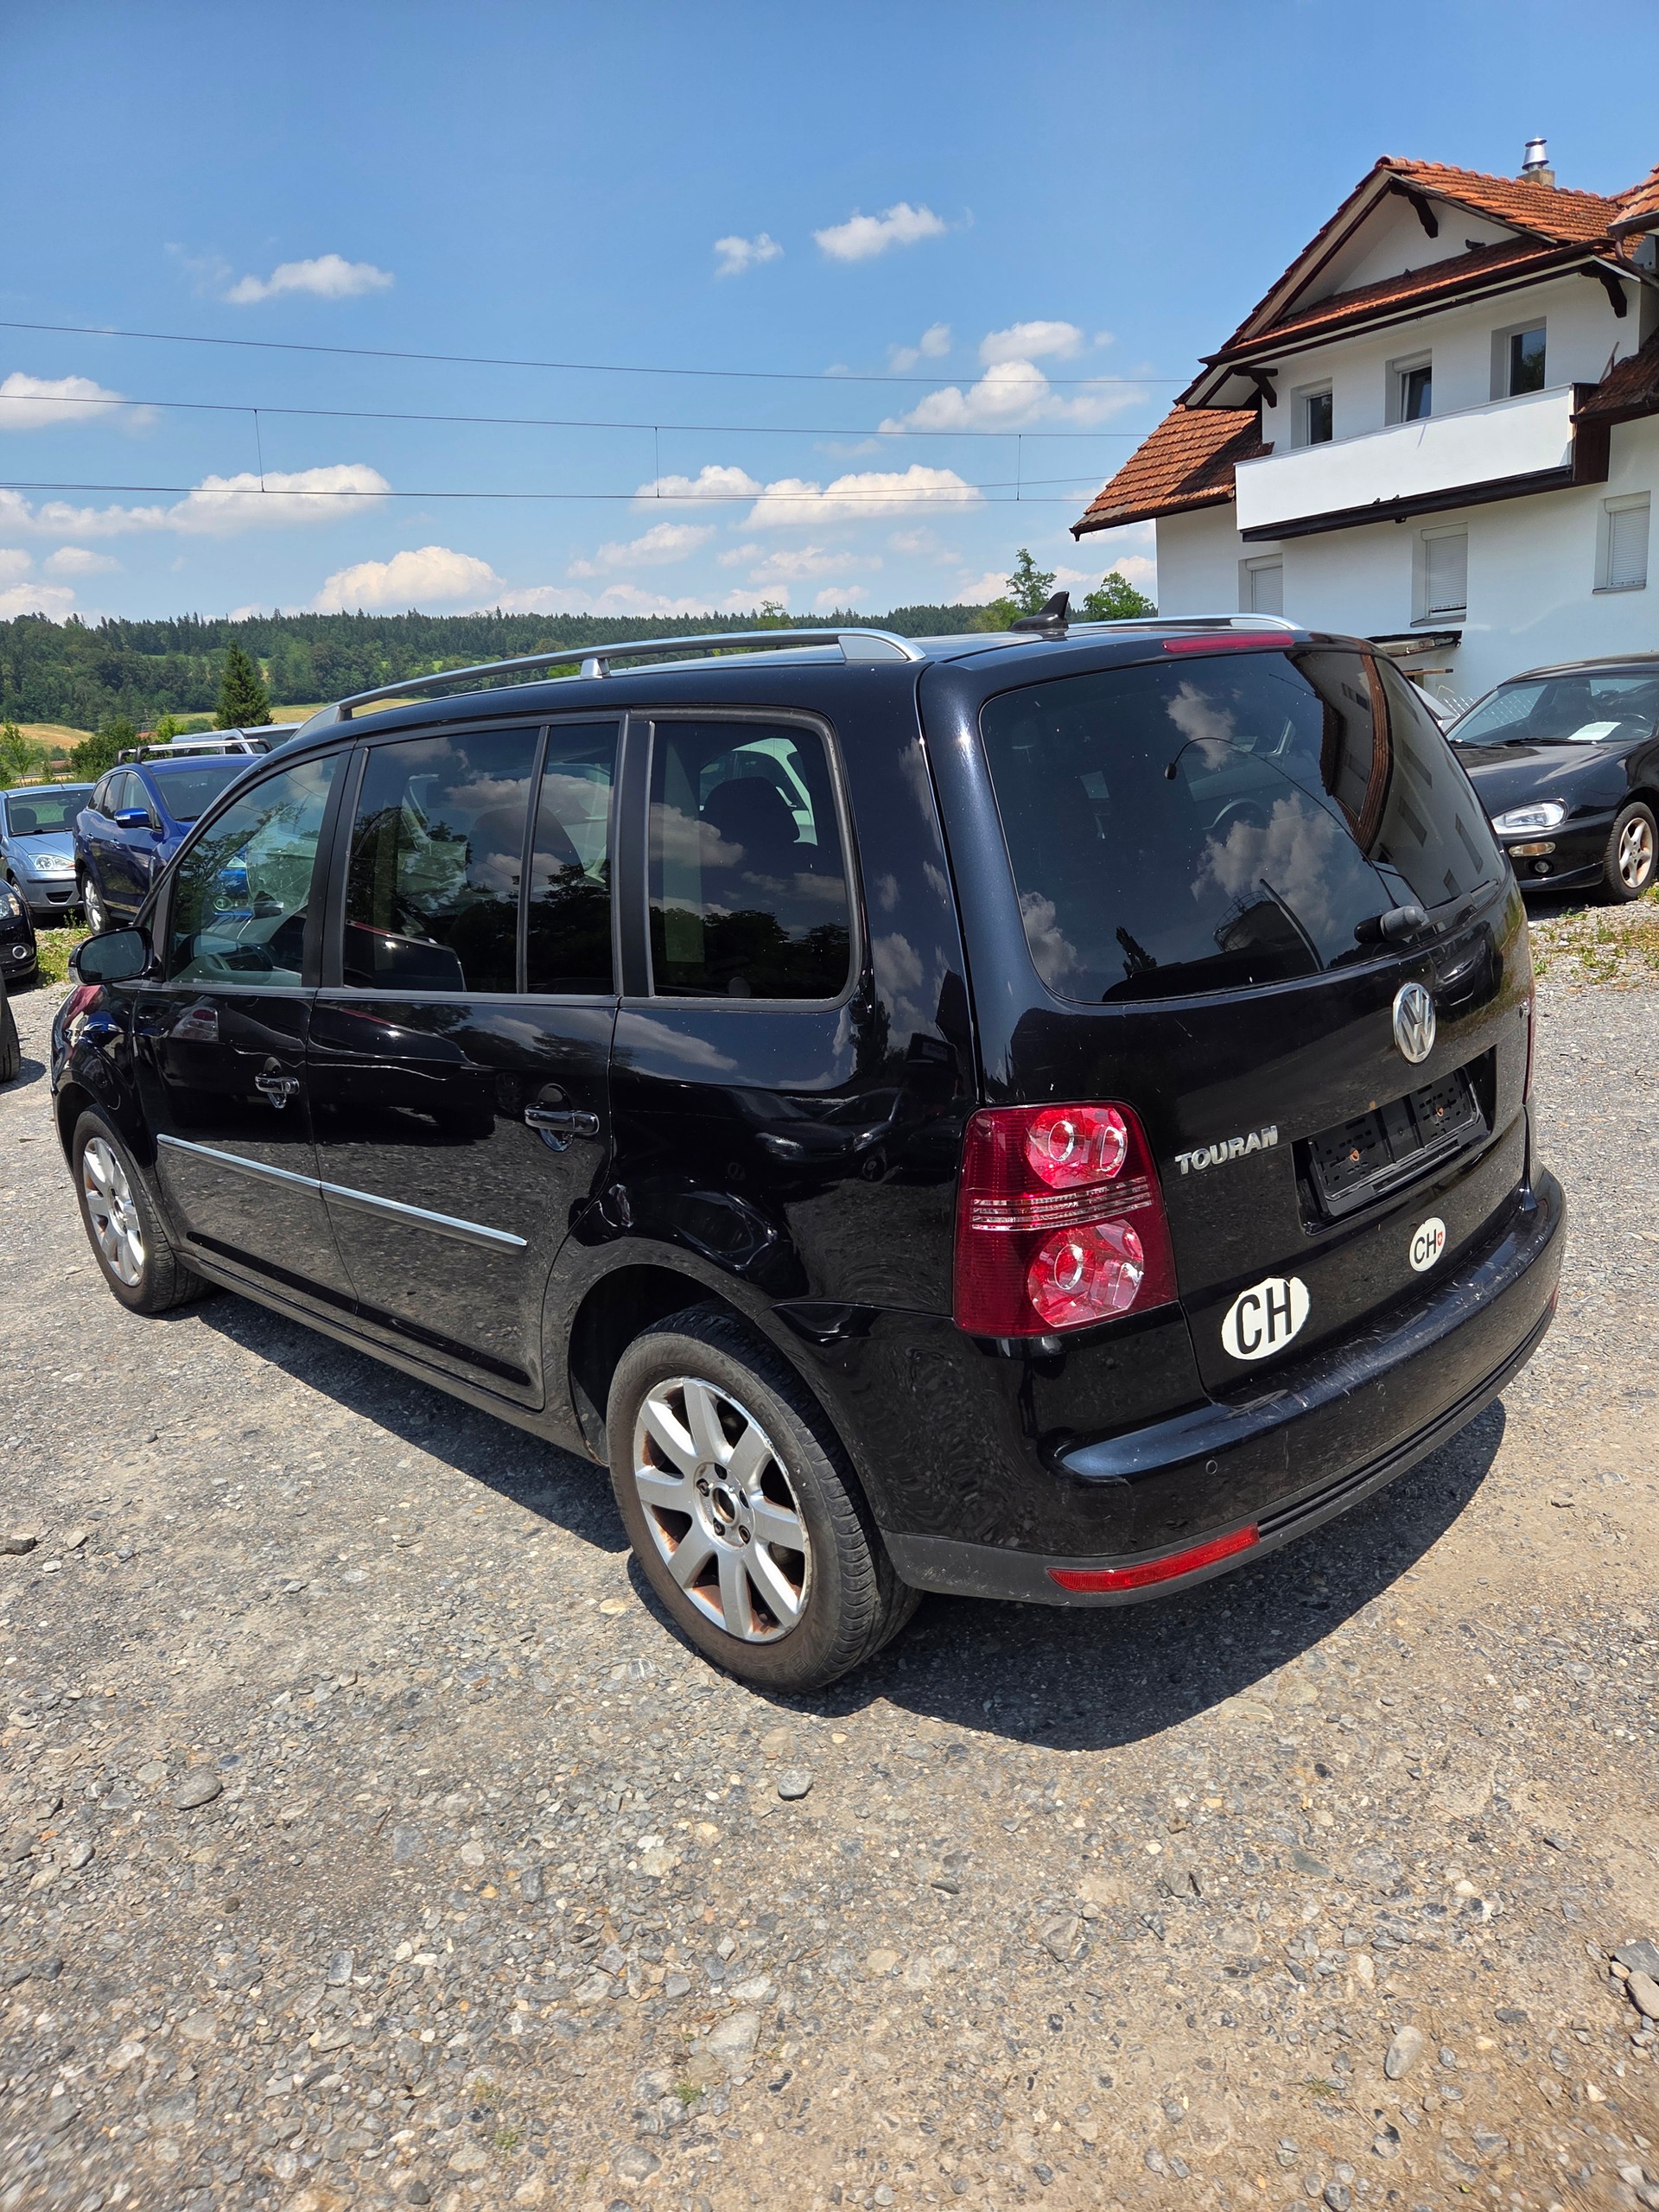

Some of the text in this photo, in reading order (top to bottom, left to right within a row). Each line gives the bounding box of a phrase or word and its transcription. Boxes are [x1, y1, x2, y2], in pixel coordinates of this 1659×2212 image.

[1394, 983, 1434, 1062] VW
[1175, 1125, 1278, 1174] TOURAN
[1414, 1229, 1437, 1264] CH
[1236, 1281, 1292, 1355] CH
